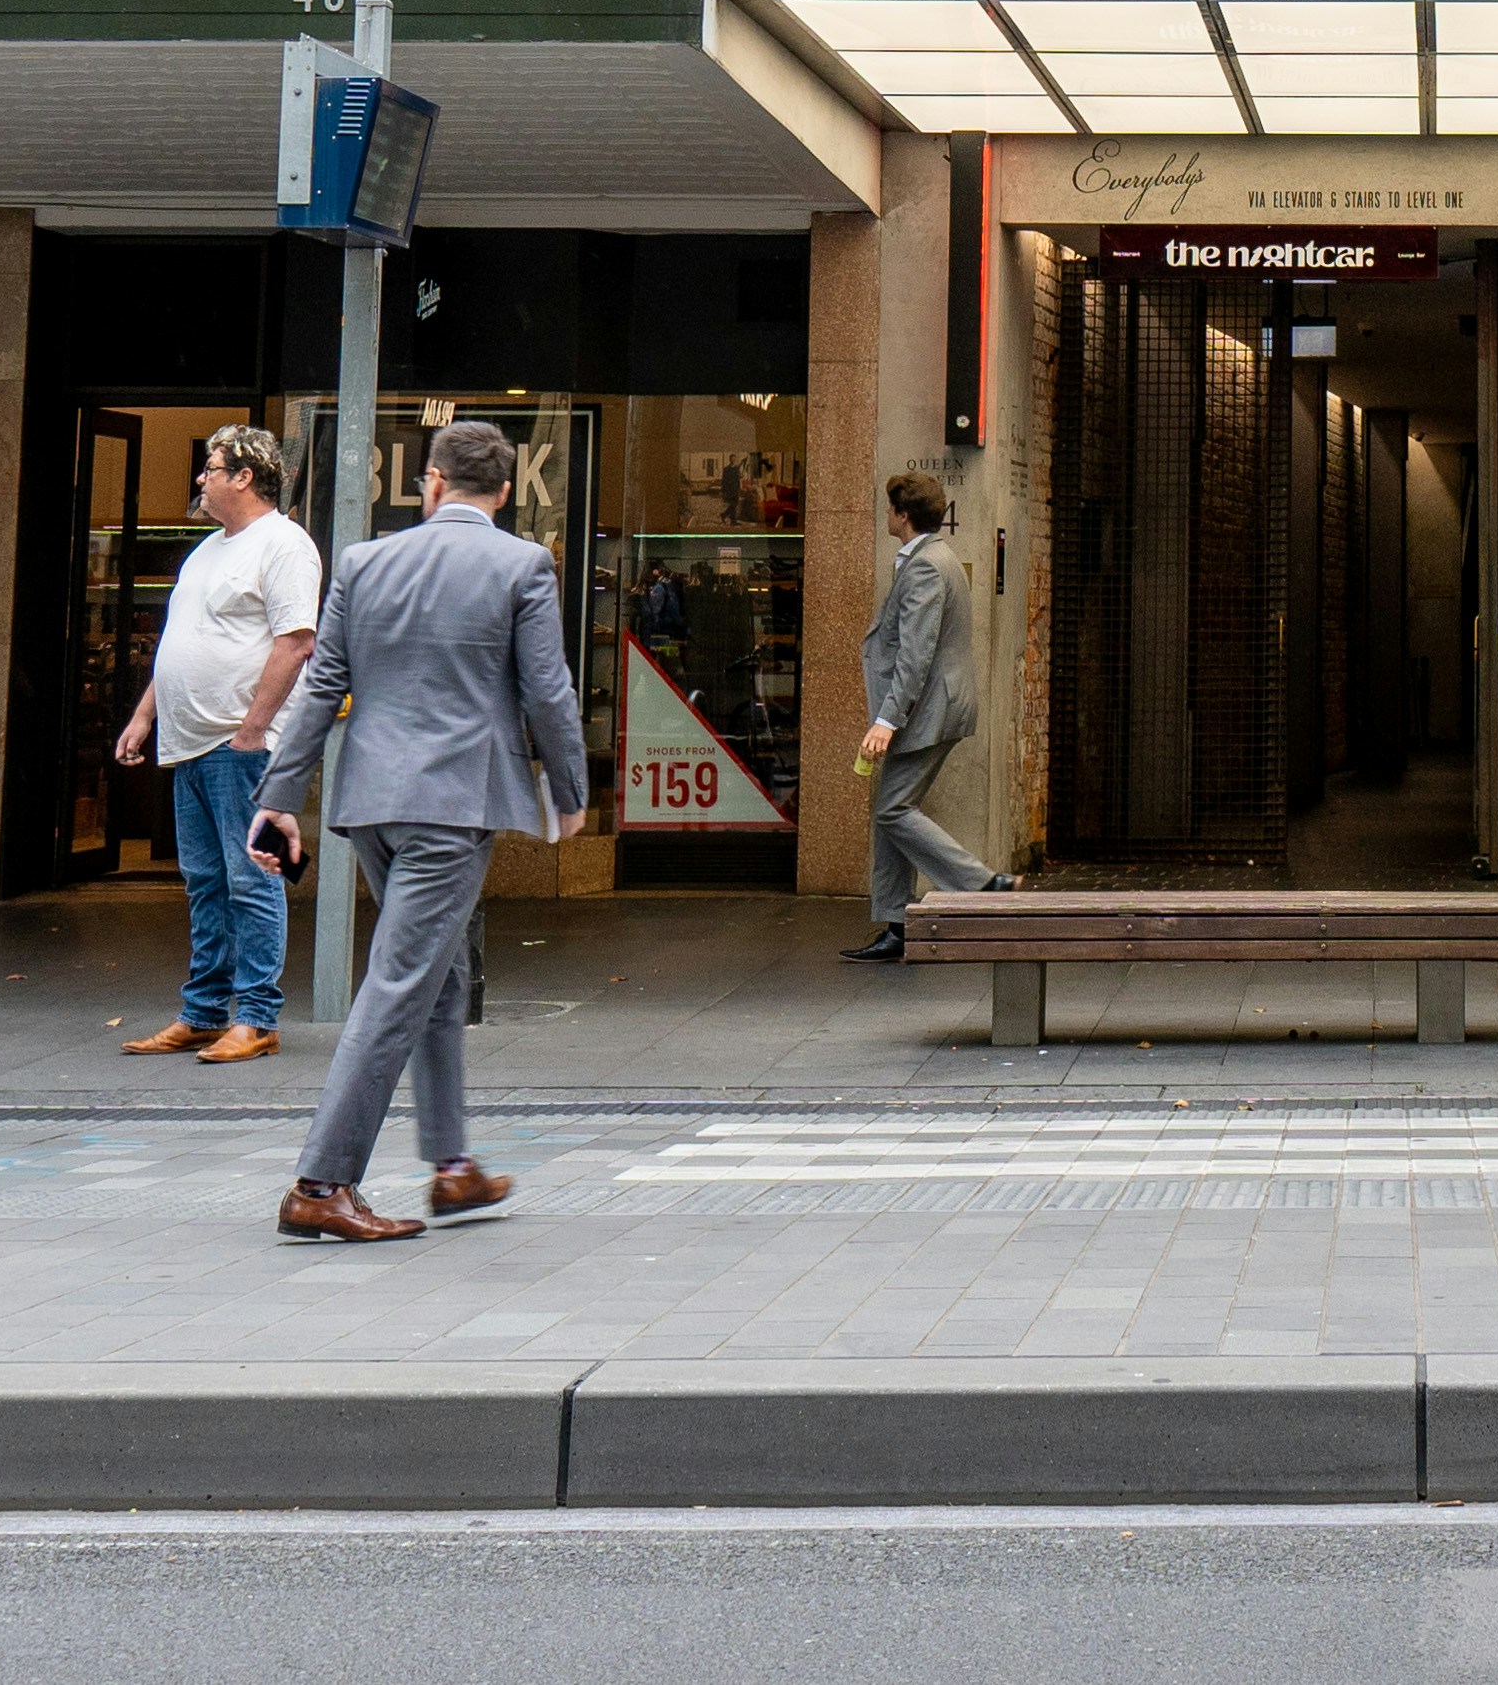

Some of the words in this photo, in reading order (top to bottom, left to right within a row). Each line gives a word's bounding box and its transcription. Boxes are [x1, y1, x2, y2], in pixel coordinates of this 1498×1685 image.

[1072, 138, 1206, 221] Everybody's
[1247, 191, 1266, 209] VIA
[1273, 191, 1323, 209] ELEVATOR
[1344, 191, 1381, 209] STAIRS
[1388, 192, 1401, 209] TO
[1407, 192, 1438, 209] LEVEL
[1445, 191, 1464, 209] ONE
[1165, 239, 1221, 267] the
[906, 458, 965, 472] QUEEN
[645, 746, 683, 756] SHOES
[685, 746, 716, 756] FROM
[631, 761, 719, 809] $159
